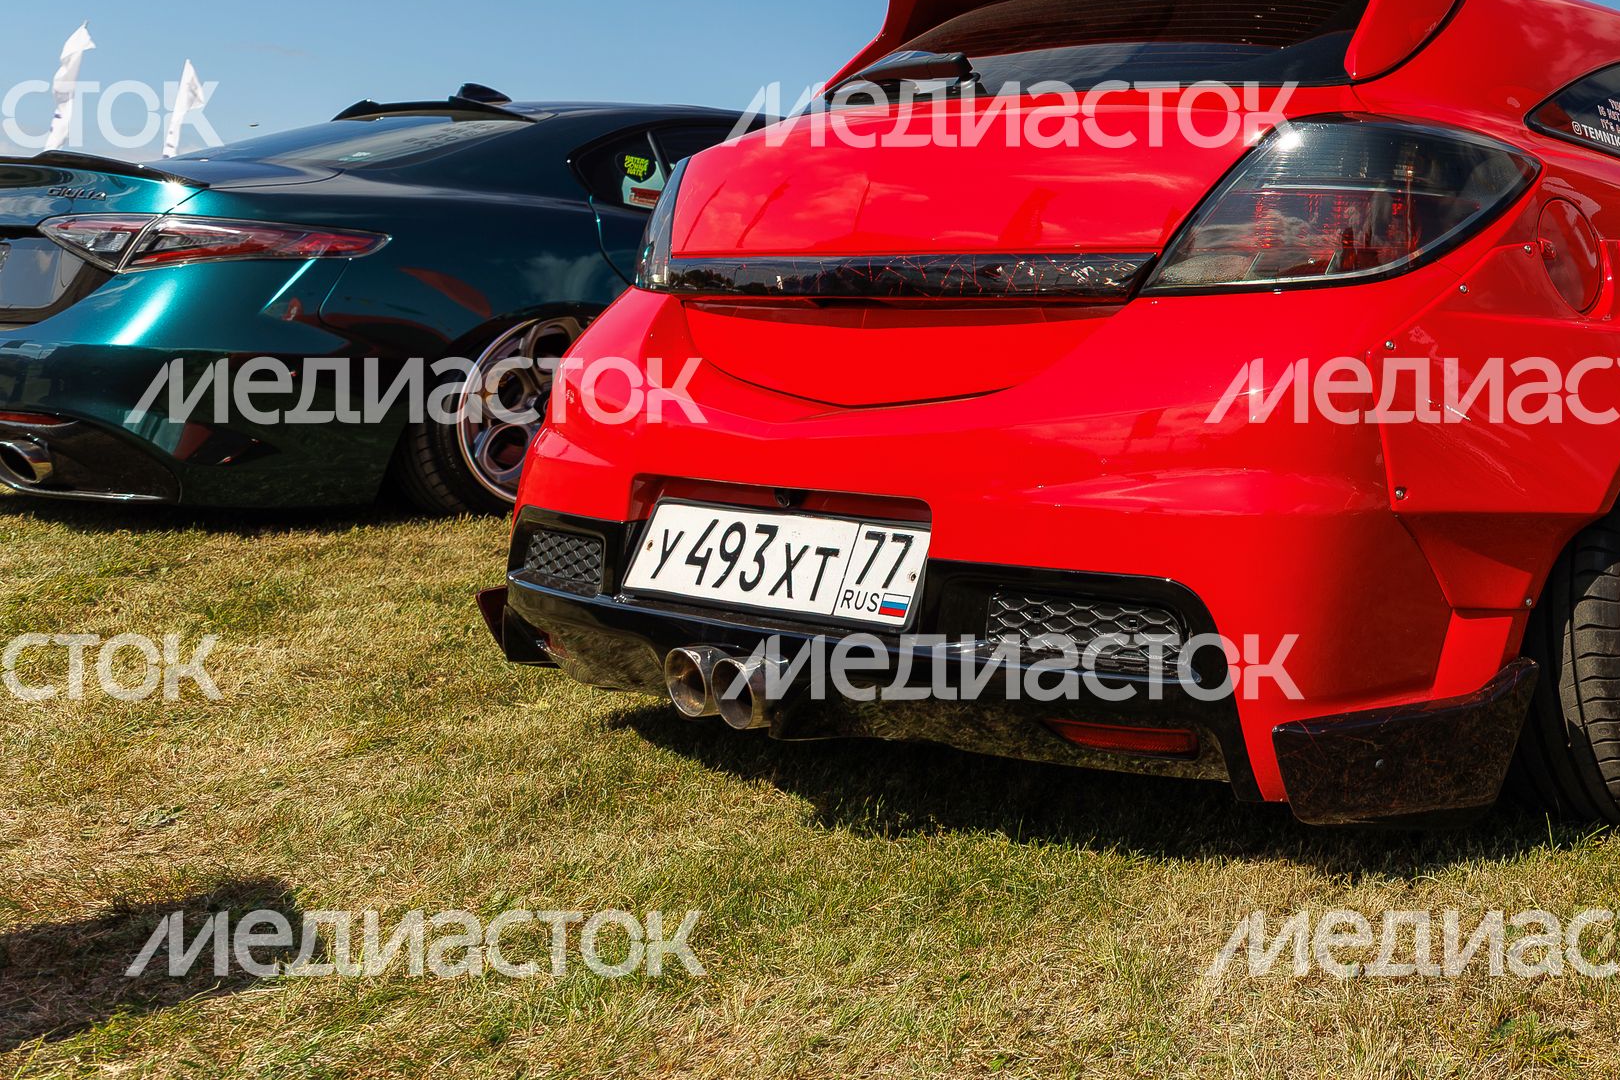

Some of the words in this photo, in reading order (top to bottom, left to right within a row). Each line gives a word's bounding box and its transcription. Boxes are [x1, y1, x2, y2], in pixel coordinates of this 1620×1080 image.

[48, 187, 106, 201] GIULIA
[855, 530, 914, 588] 77
[840, 589, 880, 612] RUS
